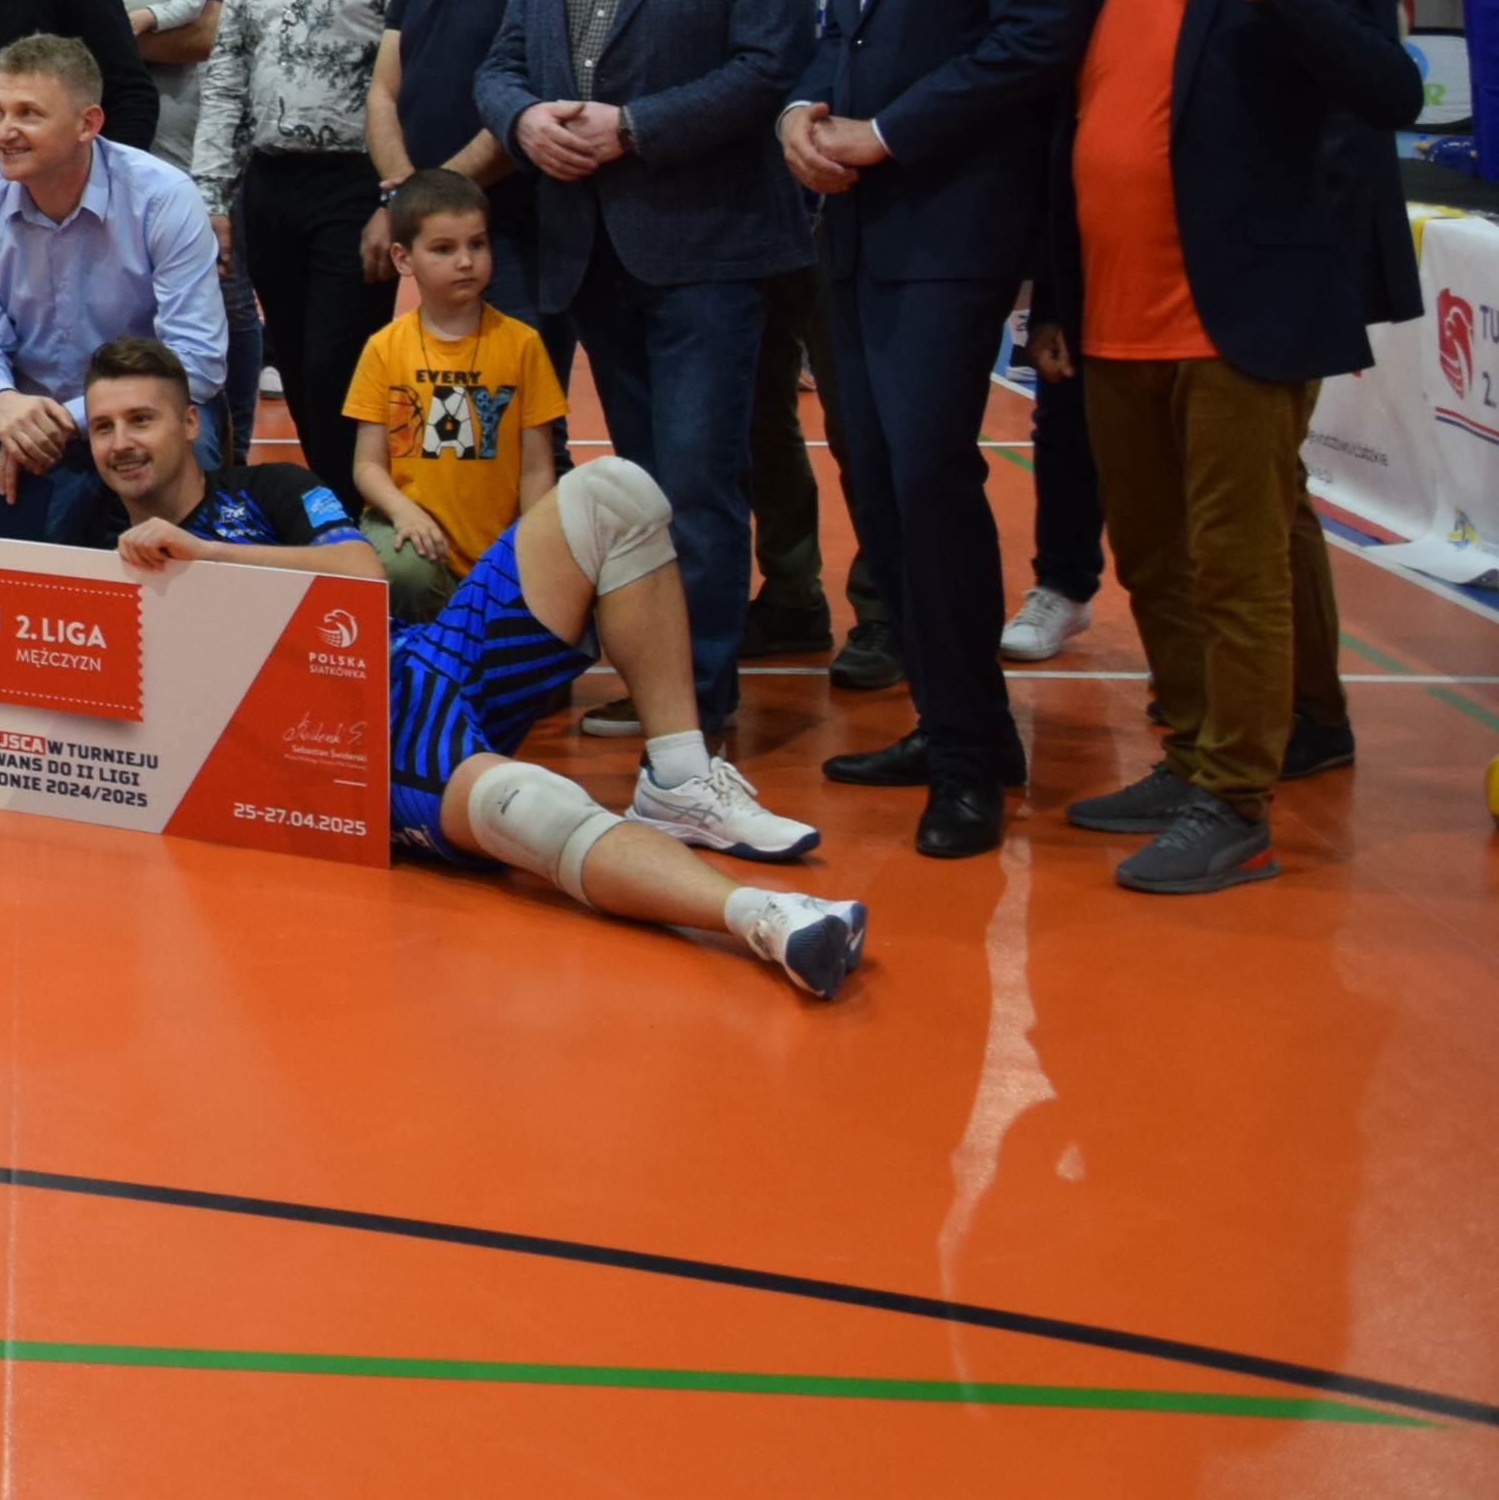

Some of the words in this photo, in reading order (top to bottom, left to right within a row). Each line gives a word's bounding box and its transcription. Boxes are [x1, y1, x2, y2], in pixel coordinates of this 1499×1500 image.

[415, 370, 482, 385] EVERY
[388, 385, 517, 460] DAY
[41, 617, 107, 649] LIGA
[15, 648, 102, 672] MĘŻCZYZN
[308, 652, 366, 669] POLSKA
[309, 664, 366, 680] SIATKÓWKA
[46, 739, 65, 755] W
[66, 743, 158, 770] TURNIEJU
[291, 744, 329, 757] Sebastian
[47, 759, 72, 777] DO
[76, 763, 94, 780] II
[98, 766, 140, 787] LIGI
[46, 779, 148, 808] 2024/2025
[233, 802, 367, 836] 25-27.04.2025
